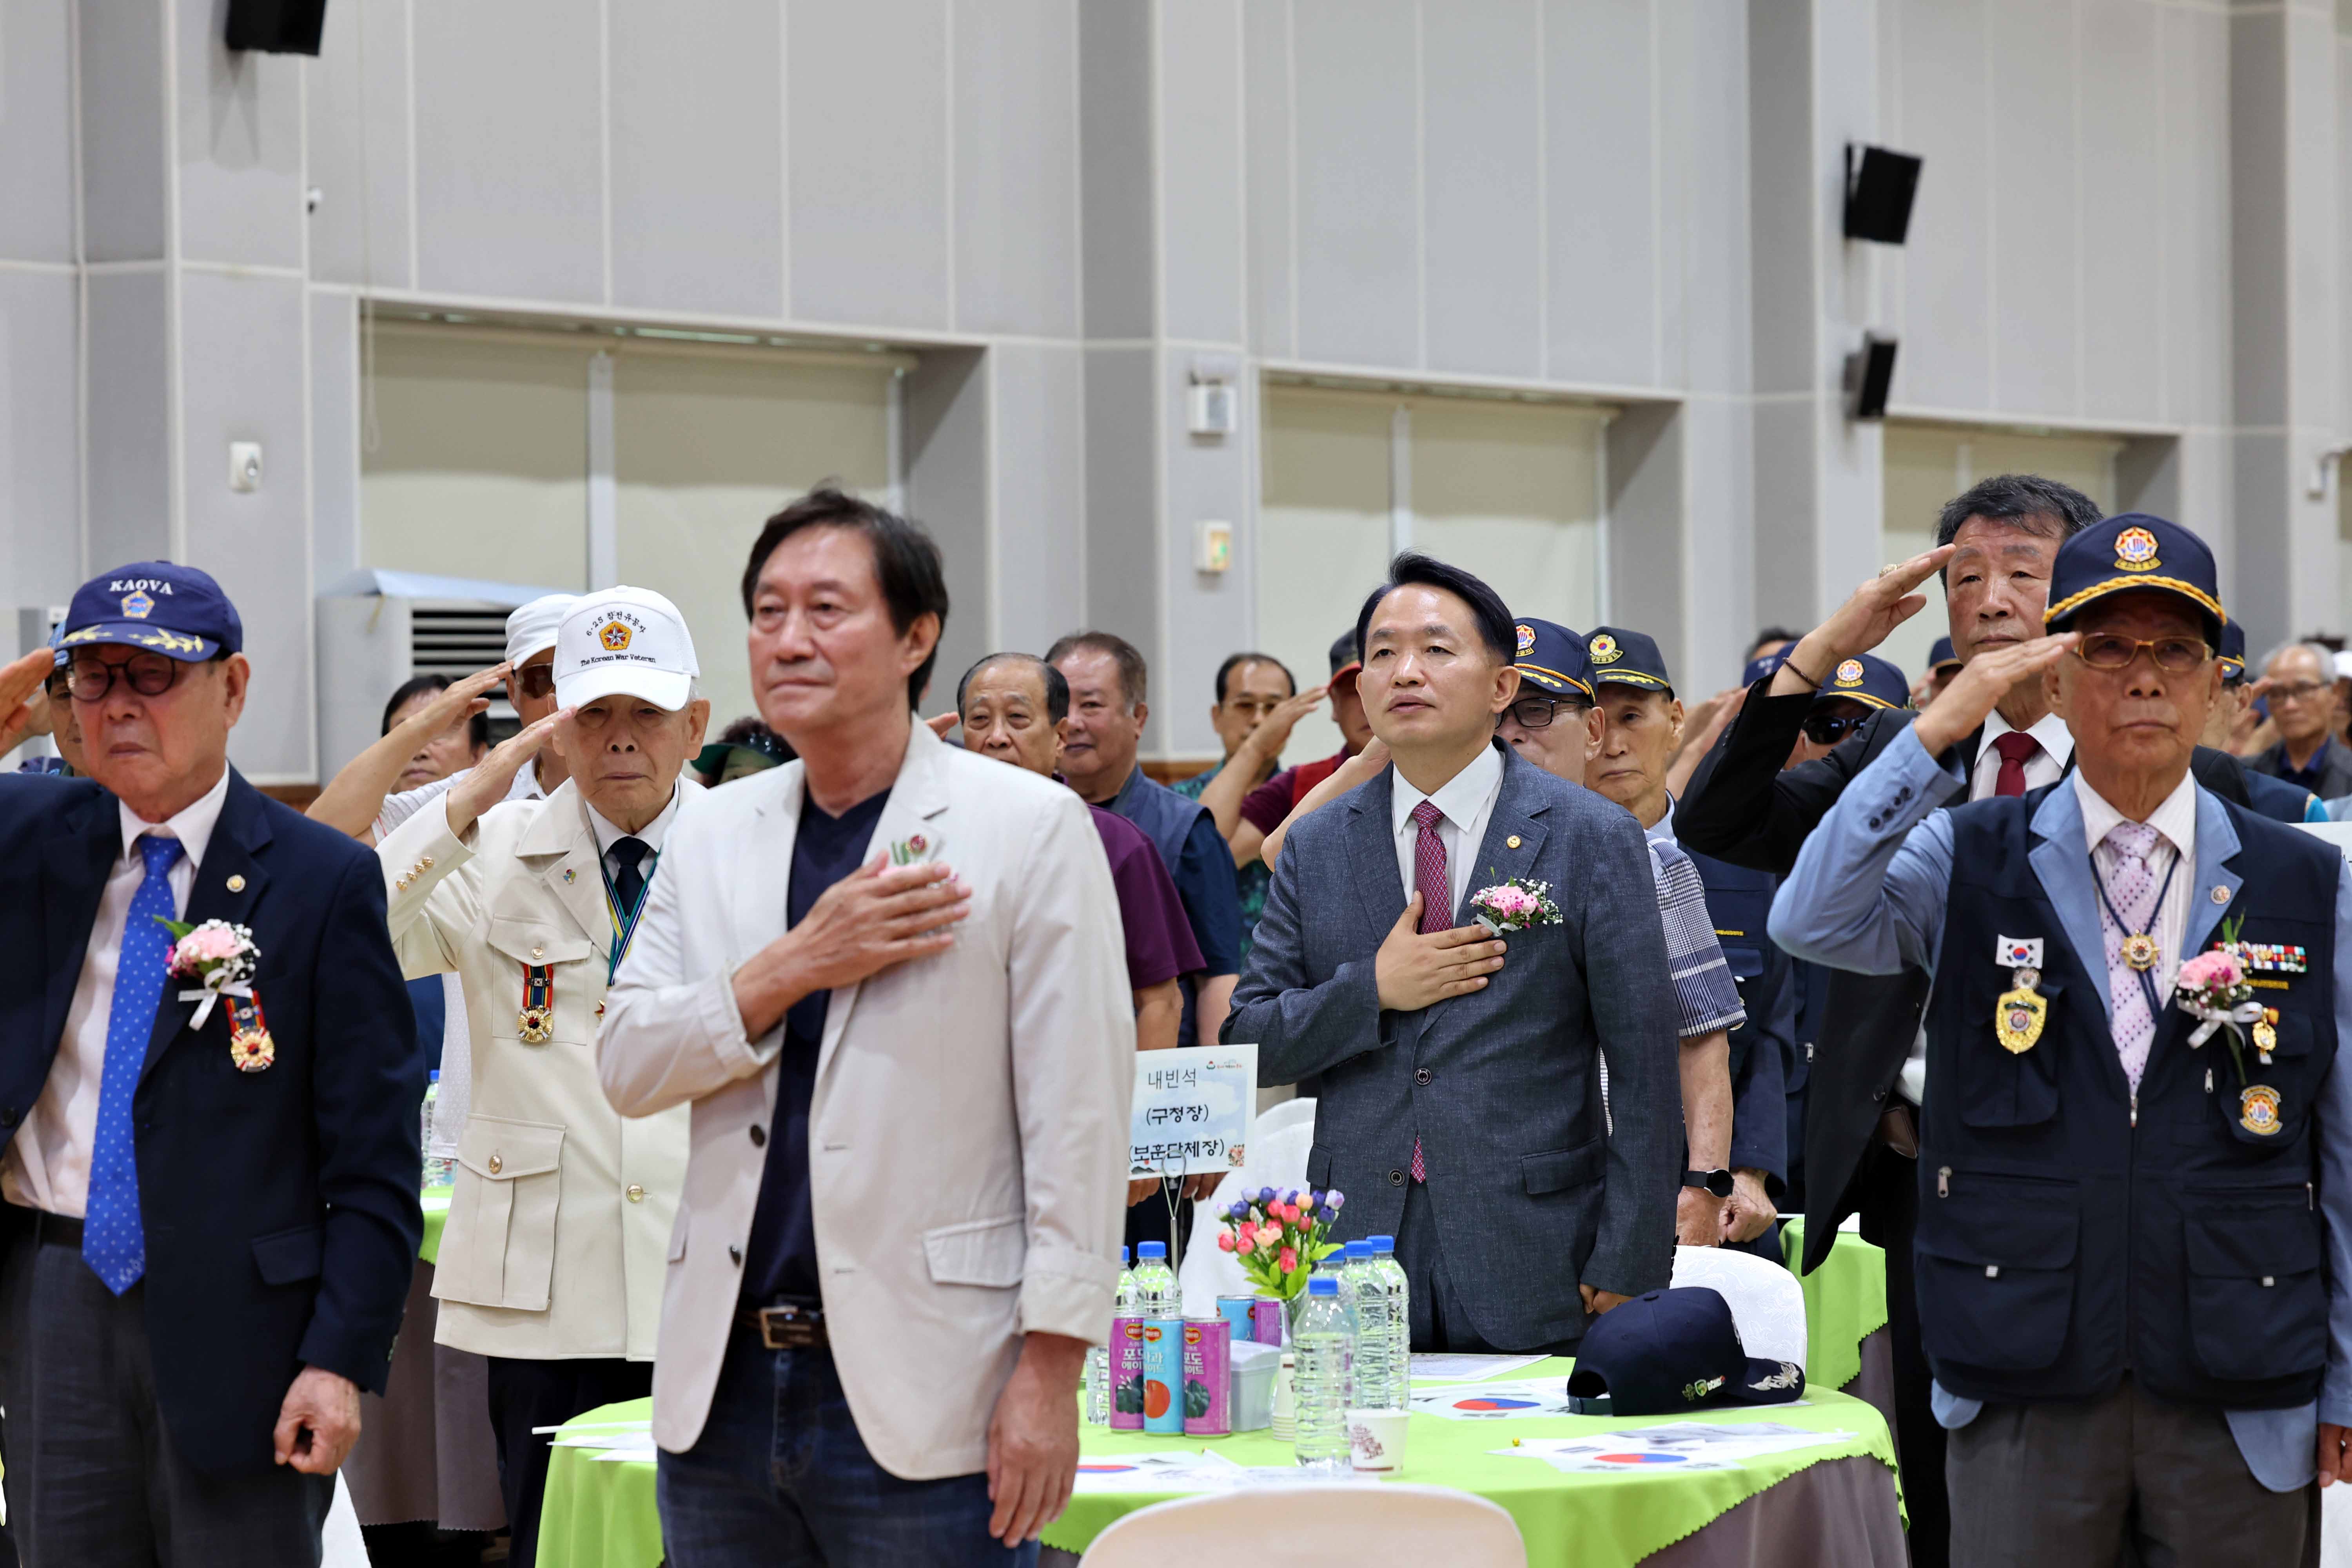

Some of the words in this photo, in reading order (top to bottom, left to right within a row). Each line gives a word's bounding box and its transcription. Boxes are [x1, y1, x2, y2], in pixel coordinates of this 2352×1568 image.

[109, 579, 174, 595] KAOVA
[630, 654, 656, 664] Veteran
[1149, 1068, 1196, 1090] 내빈석
[1146, 1104, 1209, 1126] (구청장)
[1129, 1138, 1224, 1163] (보훈단체장)
[1122, 1361, 1142, 1370] 에이
